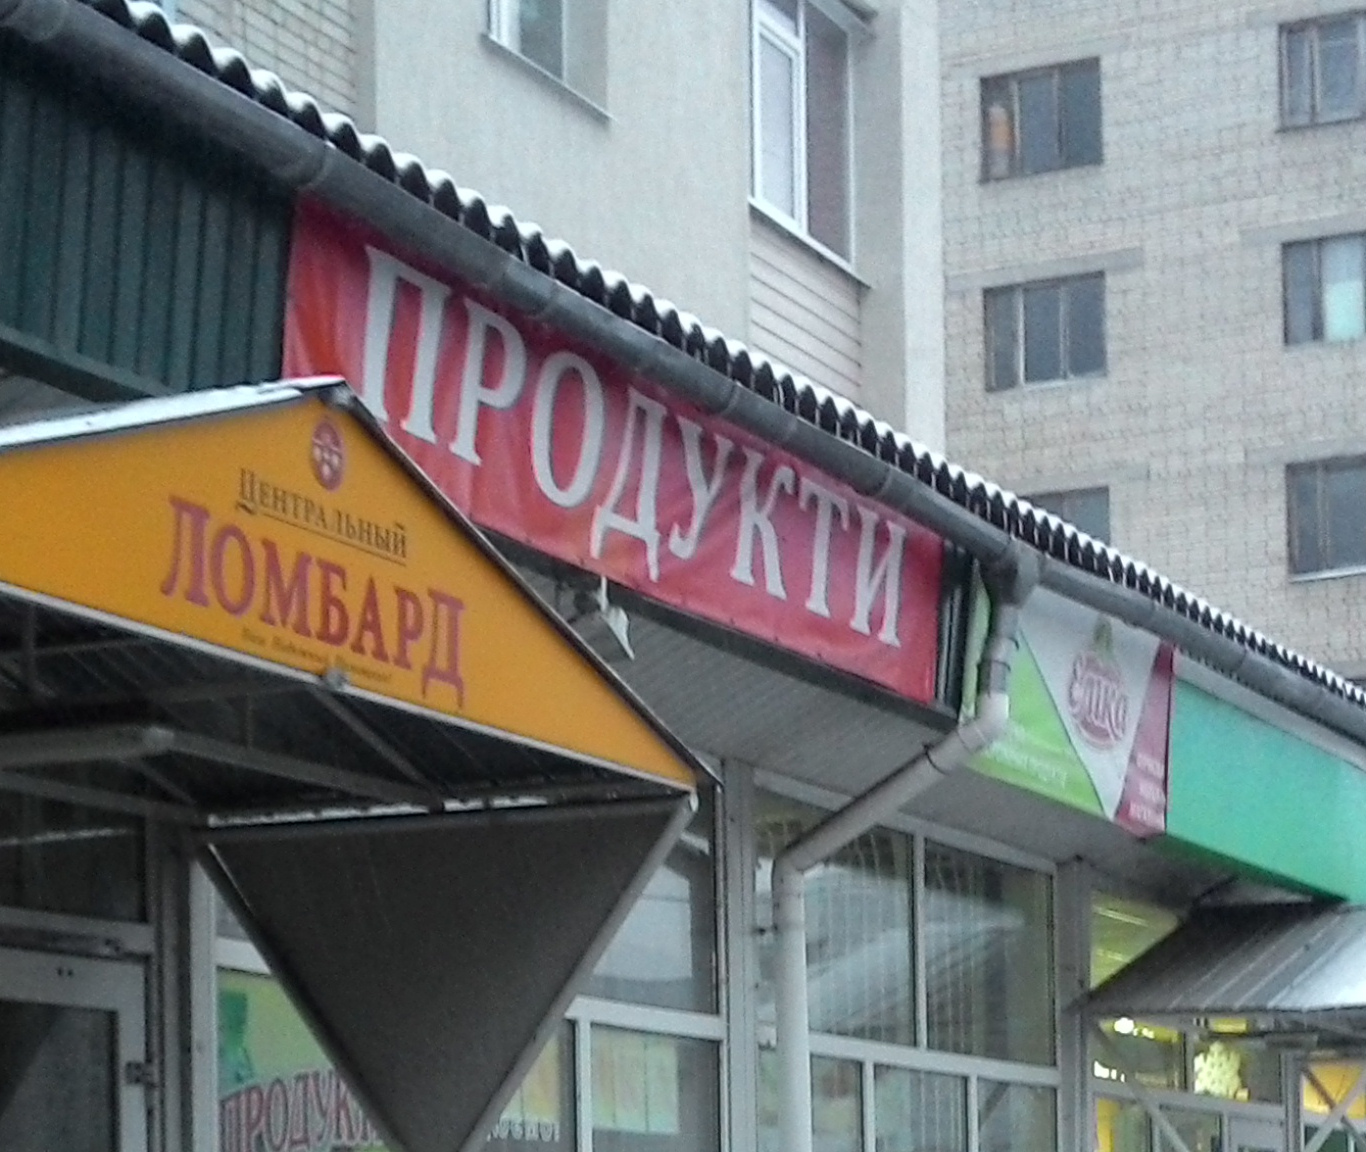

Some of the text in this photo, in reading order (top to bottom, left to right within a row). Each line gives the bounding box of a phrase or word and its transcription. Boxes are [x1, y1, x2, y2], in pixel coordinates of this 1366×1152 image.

[237, 467, 408, 560] ЦЕНТРАЛЬНЫЙ
[360, 246, 907, 648] ПРОДУКТИ
[159, 494, 467, 709] ЛОМБАРД
